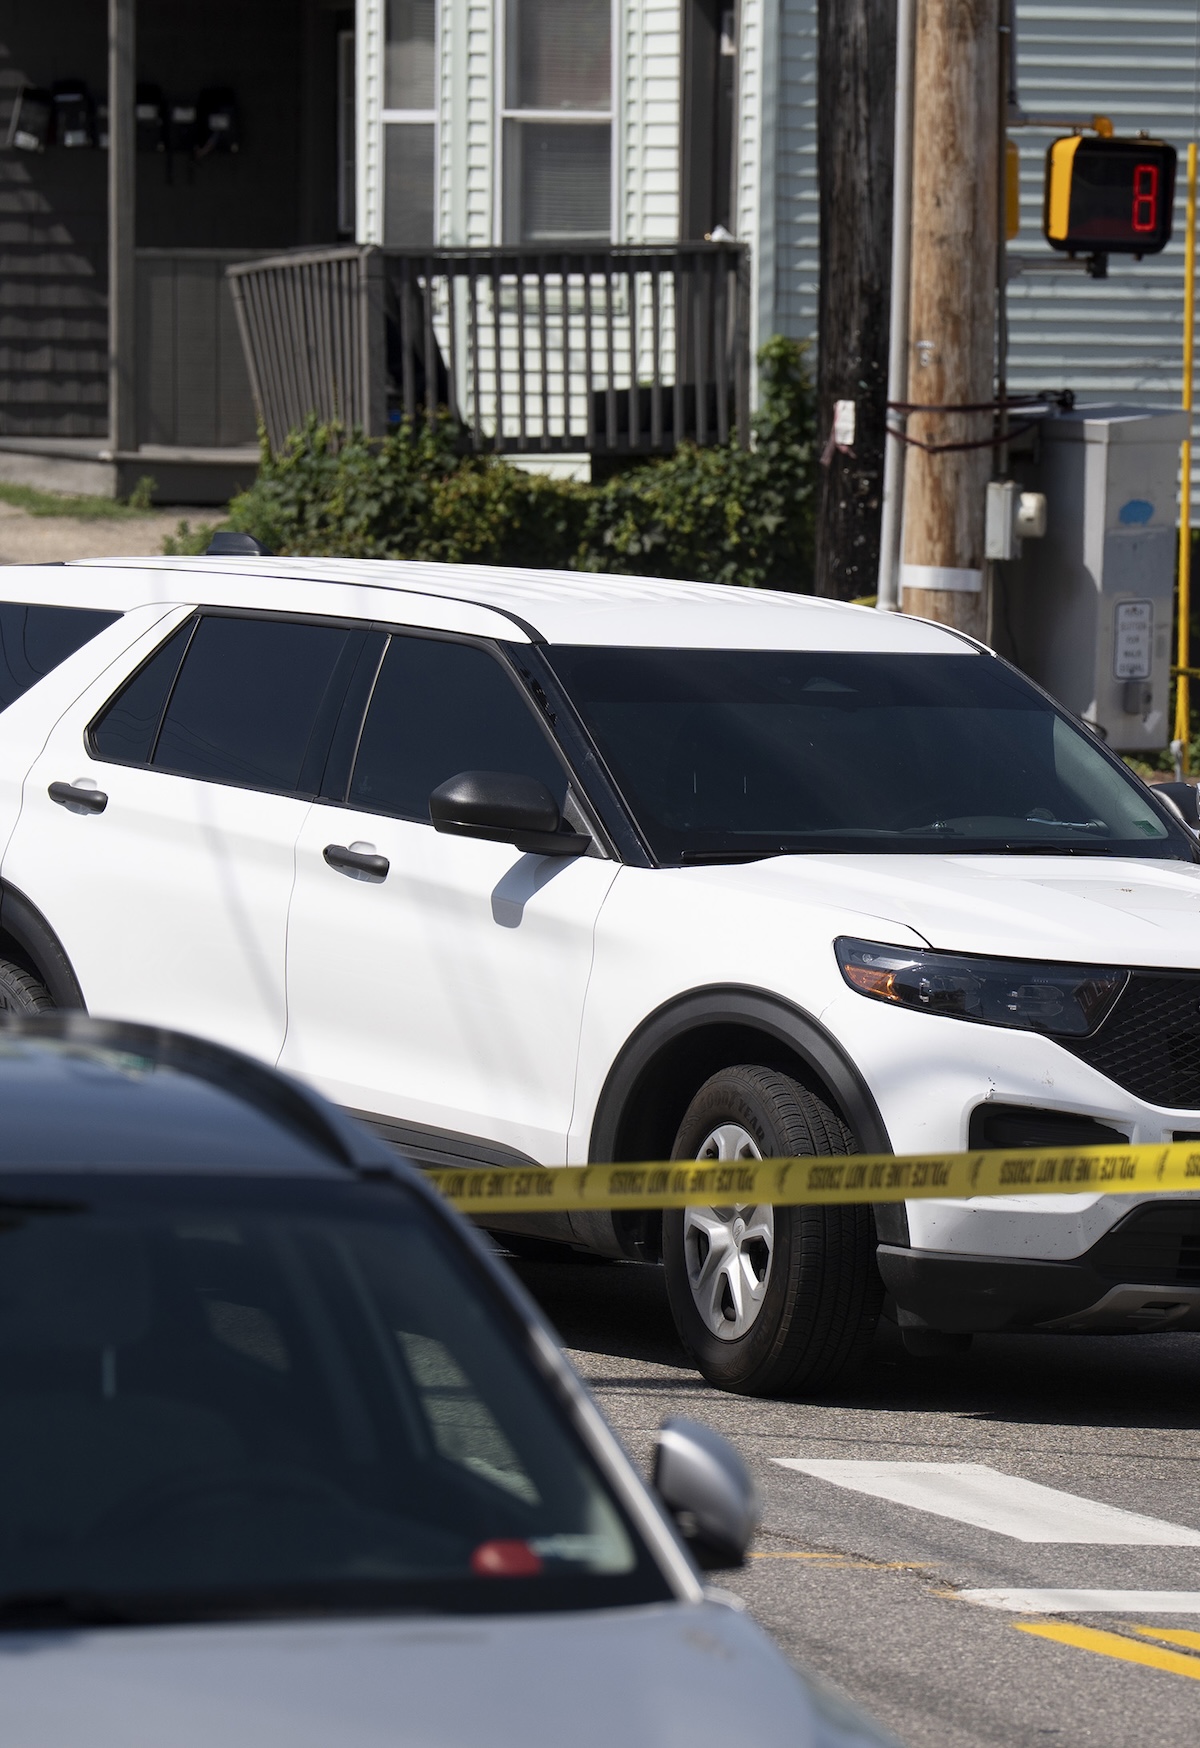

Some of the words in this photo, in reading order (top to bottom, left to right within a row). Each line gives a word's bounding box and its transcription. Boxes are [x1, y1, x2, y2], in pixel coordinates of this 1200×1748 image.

[1132, 164, 1158, 232] 8
[999, 1159, 1035, 1184] CROSS
[1035, 1158, 1058, 1183] NOT
[1058, 1157, 1075, 1182] DO
[1075, 1157, 1100, 1182] LINE
[1100, 1156, 1139, 1180] POLICE
